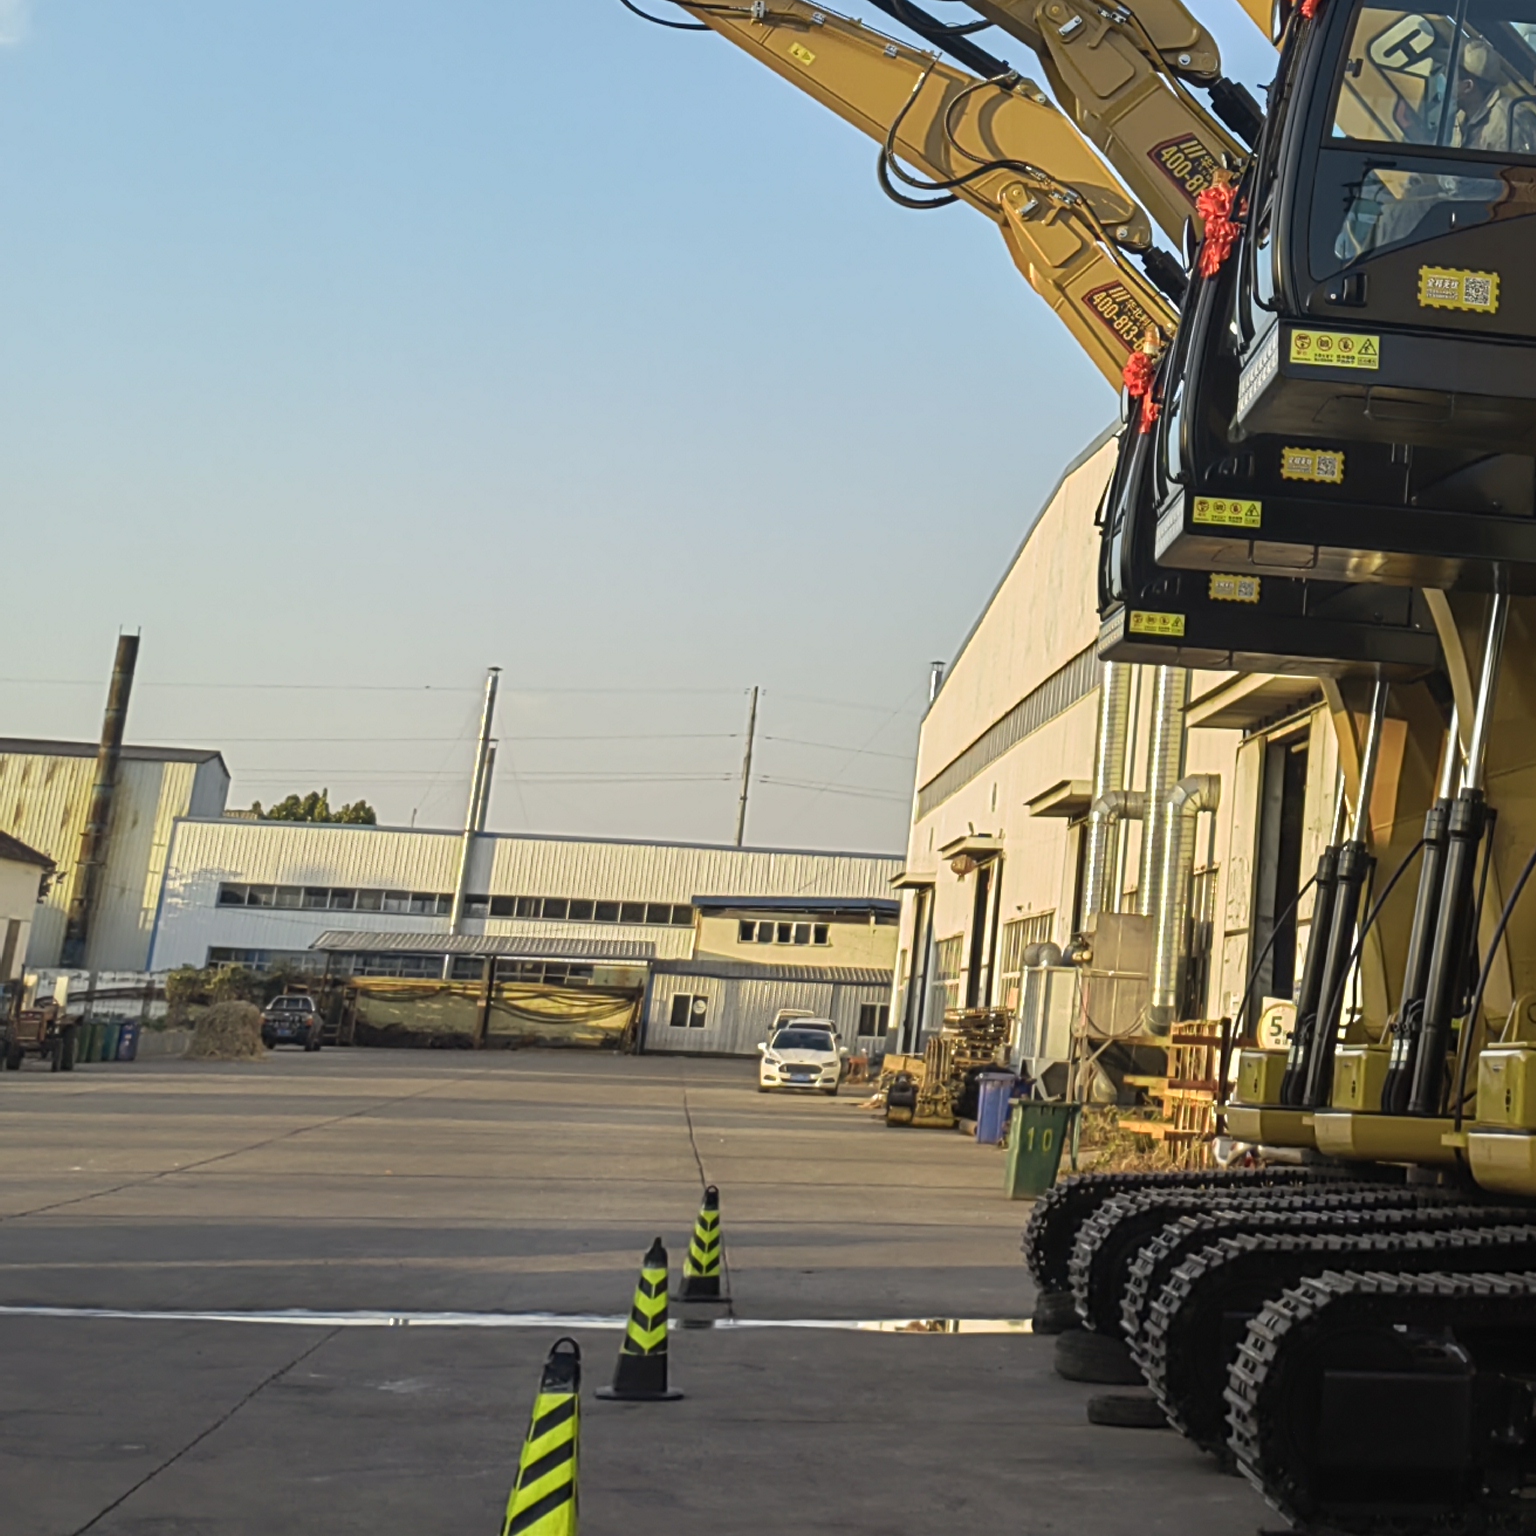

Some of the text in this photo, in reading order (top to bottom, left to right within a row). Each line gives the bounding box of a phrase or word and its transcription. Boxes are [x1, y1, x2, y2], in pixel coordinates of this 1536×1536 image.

[1160, 146, 1209, 197] 400-81
[1092, 292, 1145, 351] 400-813-6
[1028, 1126, 1053, 1152] 10
